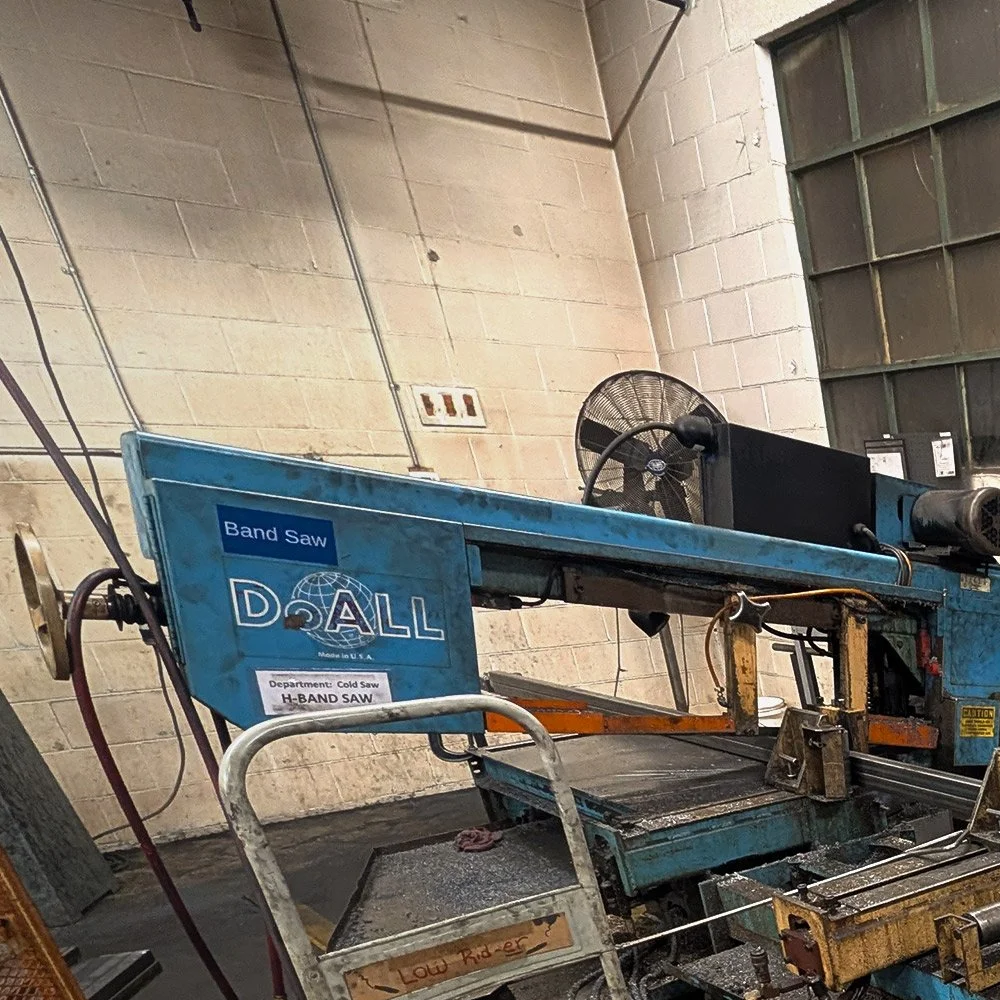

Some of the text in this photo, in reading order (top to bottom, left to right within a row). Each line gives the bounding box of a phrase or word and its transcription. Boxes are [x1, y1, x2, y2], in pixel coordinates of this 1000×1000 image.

[224, 521, 327, 548] Band Saw
[269, 680, 379, 689] Department: Cold Saw
[281, 693, 373, 704] H-BAND SAW
